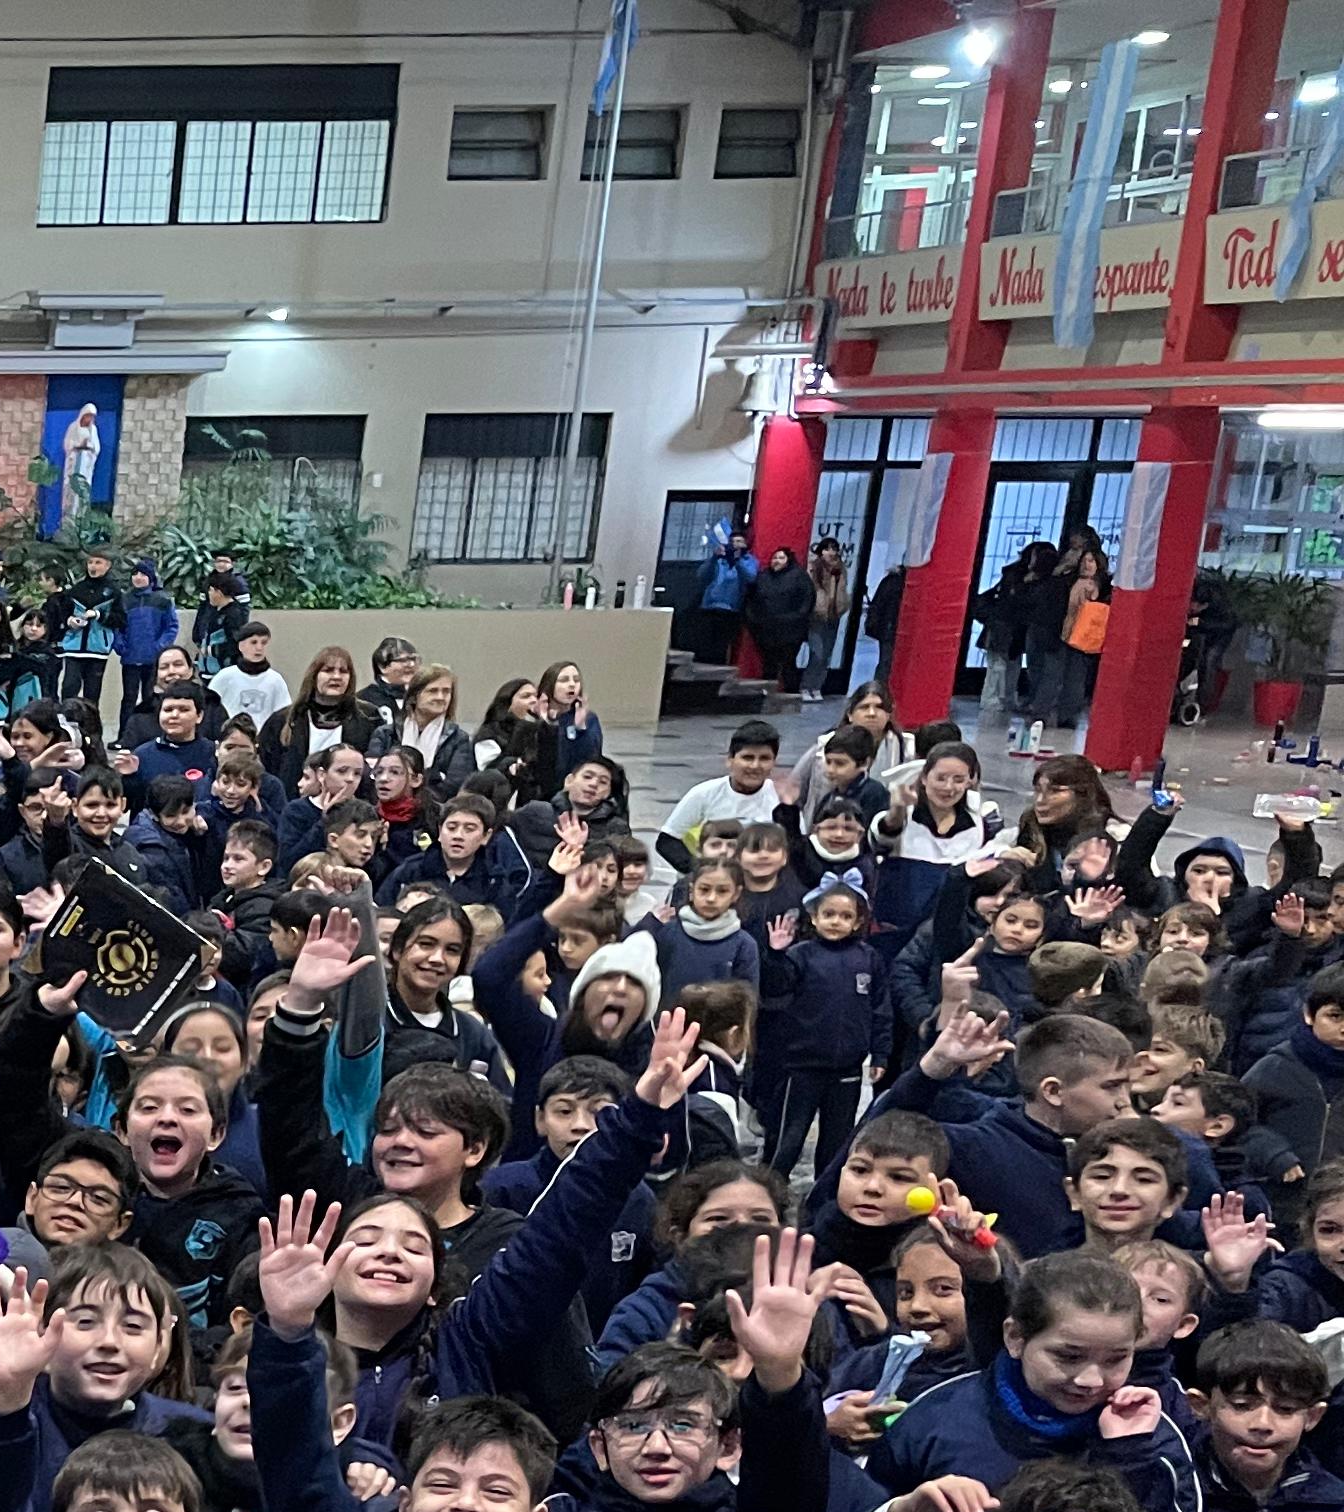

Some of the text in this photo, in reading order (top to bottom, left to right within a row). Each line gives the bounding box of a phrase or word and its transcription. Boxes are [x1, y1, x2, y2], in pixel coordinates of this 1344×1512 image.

[826, 254, 954, 318] Nada te turbe
[989, 246, 1046, 307] Nada
[1223, 219, 1280, 290] Tod
